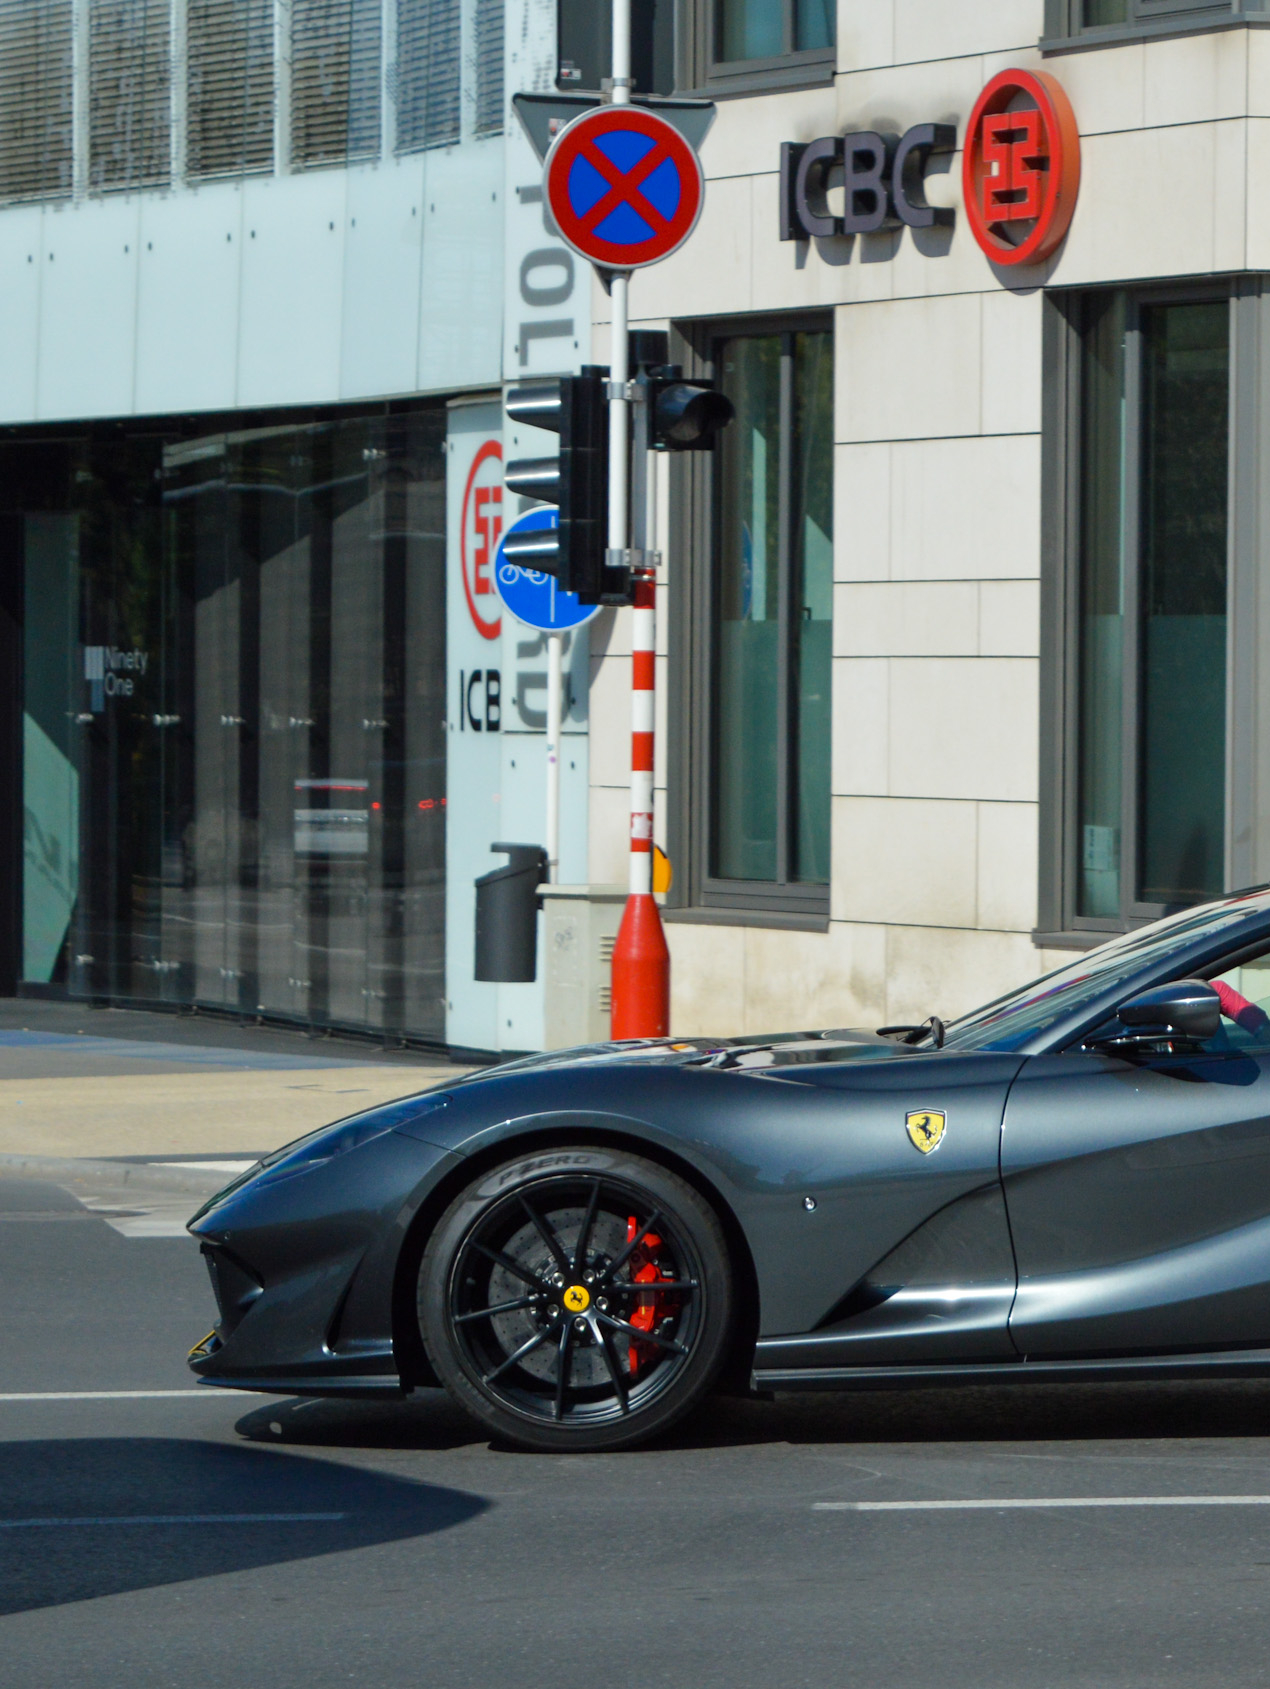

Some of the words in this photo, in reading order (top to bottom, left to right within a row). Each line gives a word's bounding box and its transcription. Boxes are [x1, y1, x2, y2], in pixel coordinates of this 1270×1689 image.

[780, 123, 955, 241] ICBC
[105, 646, 148, 675] Ninety
[105, 671, 133, 695] One
[500, 1171, 512, 1186] P
[520, 1155, 590, 1173] ZERO
